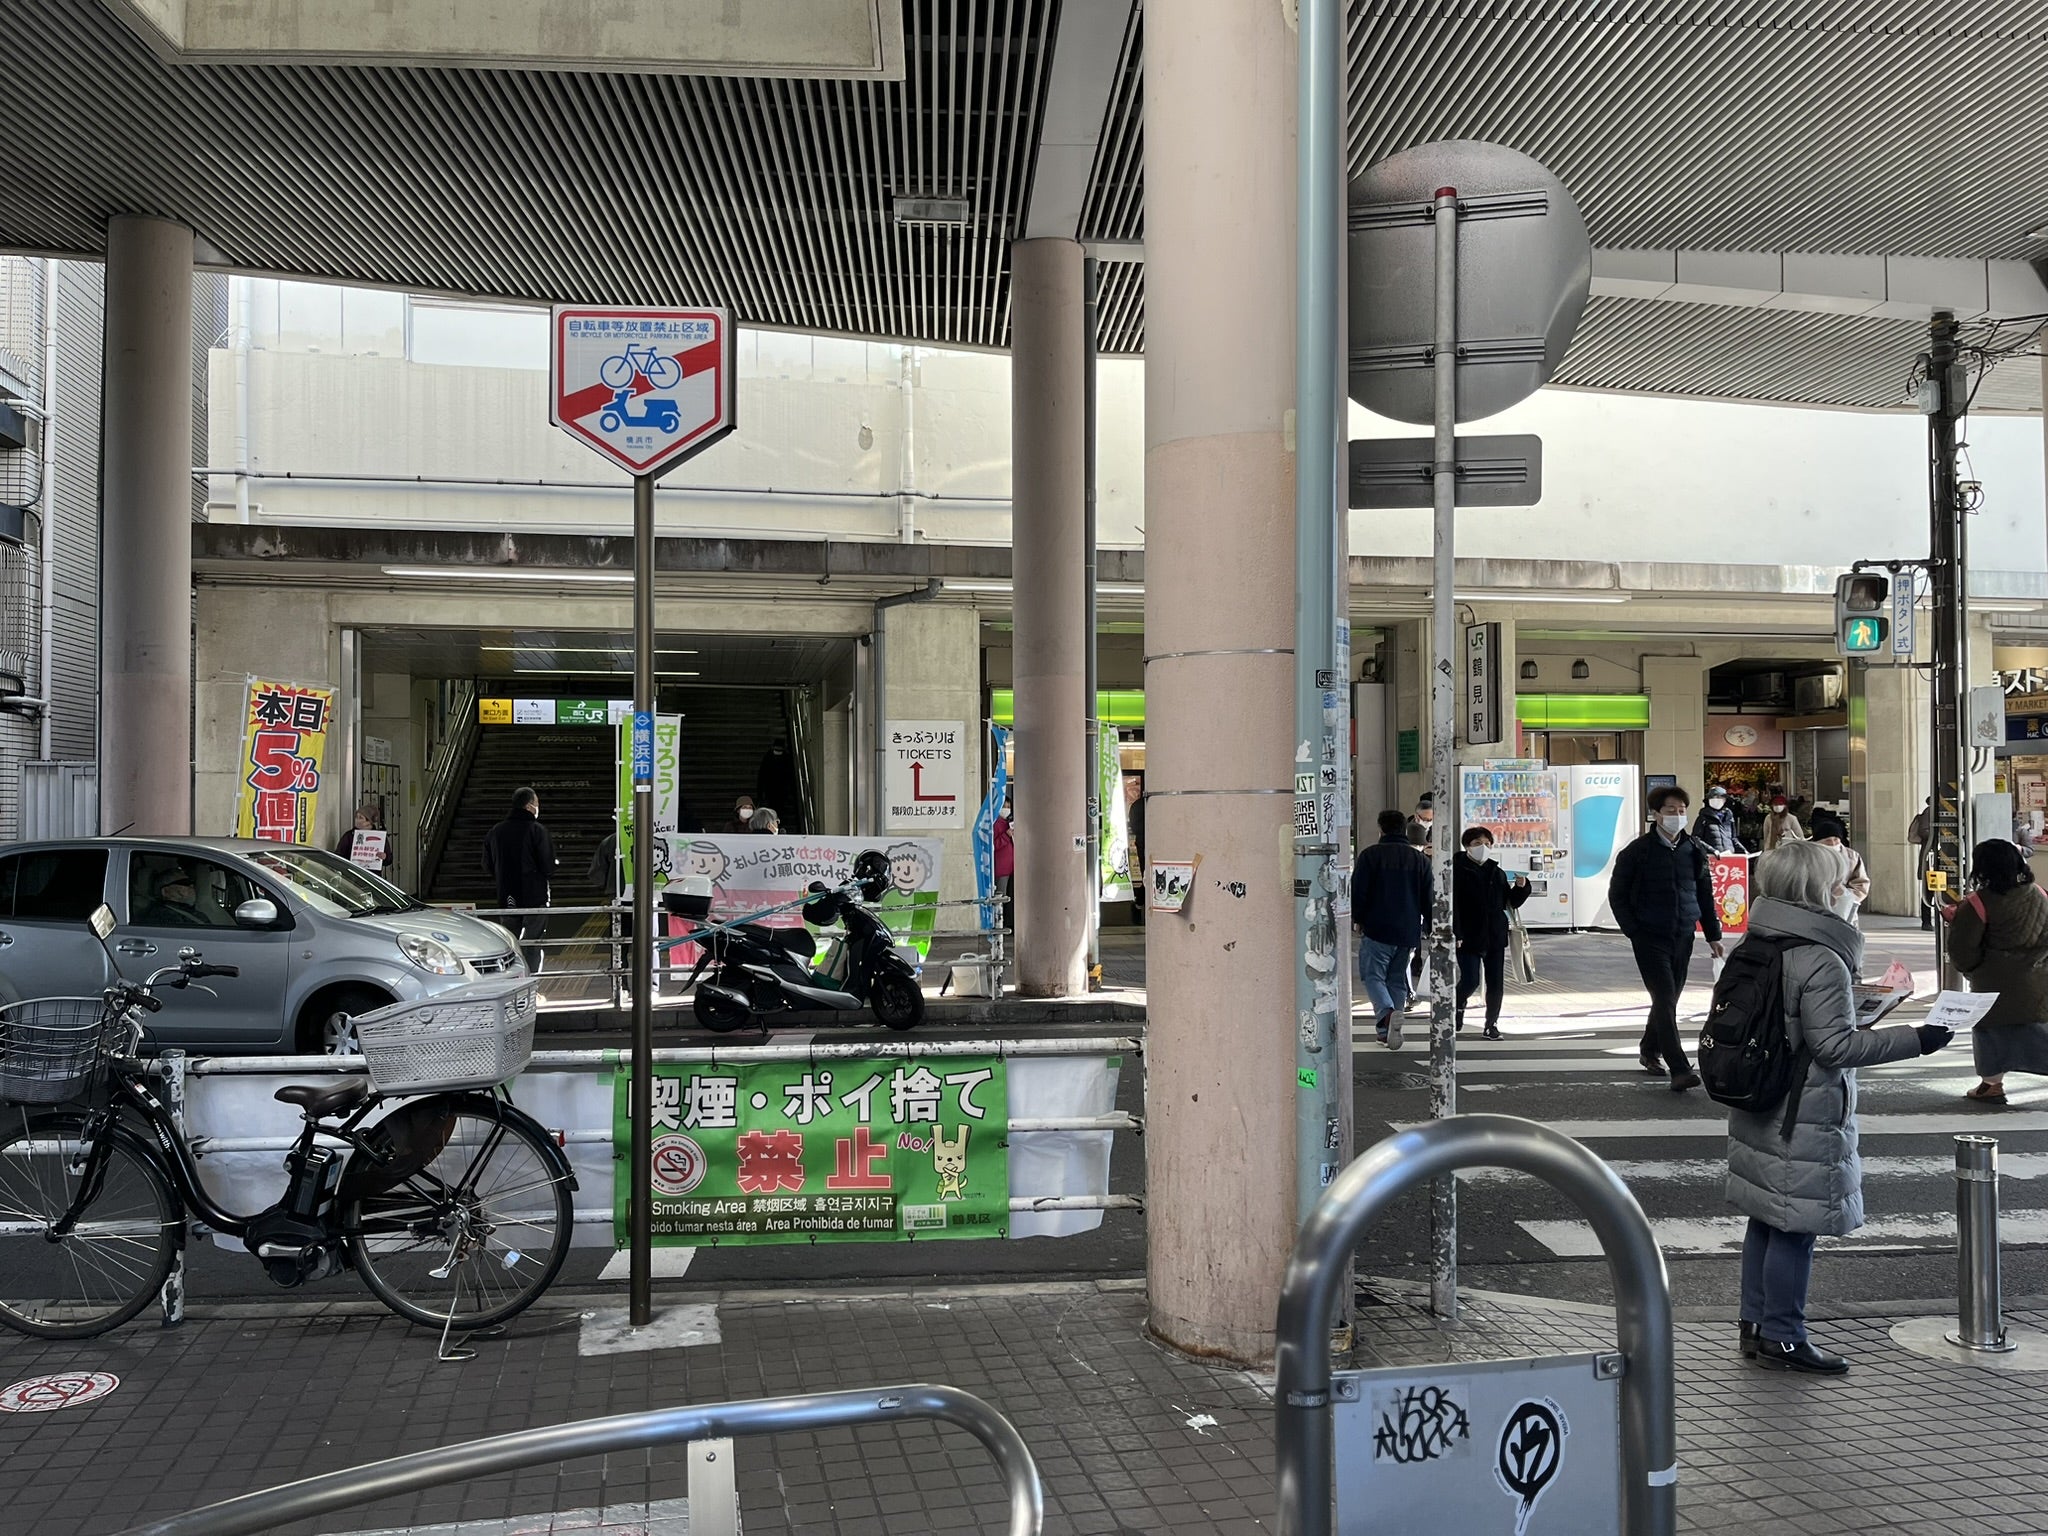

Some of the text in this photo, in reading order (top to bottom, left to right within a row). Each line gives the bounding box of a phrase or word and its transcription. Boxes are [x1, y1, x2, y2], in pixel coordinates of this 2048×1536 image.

[569, 320, 709, 334] 自転車等放置禁止区域
[626, 436, 653, 444] 横浜市
[1897, 578, 1910, 649] 押ボタン式
[1471, 632, 1484, 647] JR
[1472, 657, 1484, 732] 鶴見駅
[256, 690, 326, 732] 本日
[2015, 699, 2048, 710] MARKET
[585, 710, 604, 720] JR
[892, 730, 956, 744] きっぷうりば
[634, 728, 651, 775] 横浜市
[897, 749, 952, 760] TICKETS
[249, 732, 319, 791] 5%
[1585, 774, 1621, 785] acure
[1537, 871, 1565, 879] acure
[628, 1066, 993, 1131] 喫煙・ポイ捨て
[897, 1131, 935, 1153] No!
[736, 1126, 892, 1194] 禁止
[652, 1200, 746, 1217] Smoking Area
[753, 1198, 807, 1213] 禁烟区域
[814, 1197, 894, 1212] 흡연금지지구
[674, 1220, 703, 1233] fumar
[706, 1221, 734, 1232] nesta
[736, 1219, 757, 1232] área
[765, 1218, 791, 1231] Area
[793, 1217, 844, 1230] Prohibida
[847, 1217, 860, 1229] de
[862, 1216, 894, 1229] fumar
[952, 1213, 991, 1225] 鶴見区
